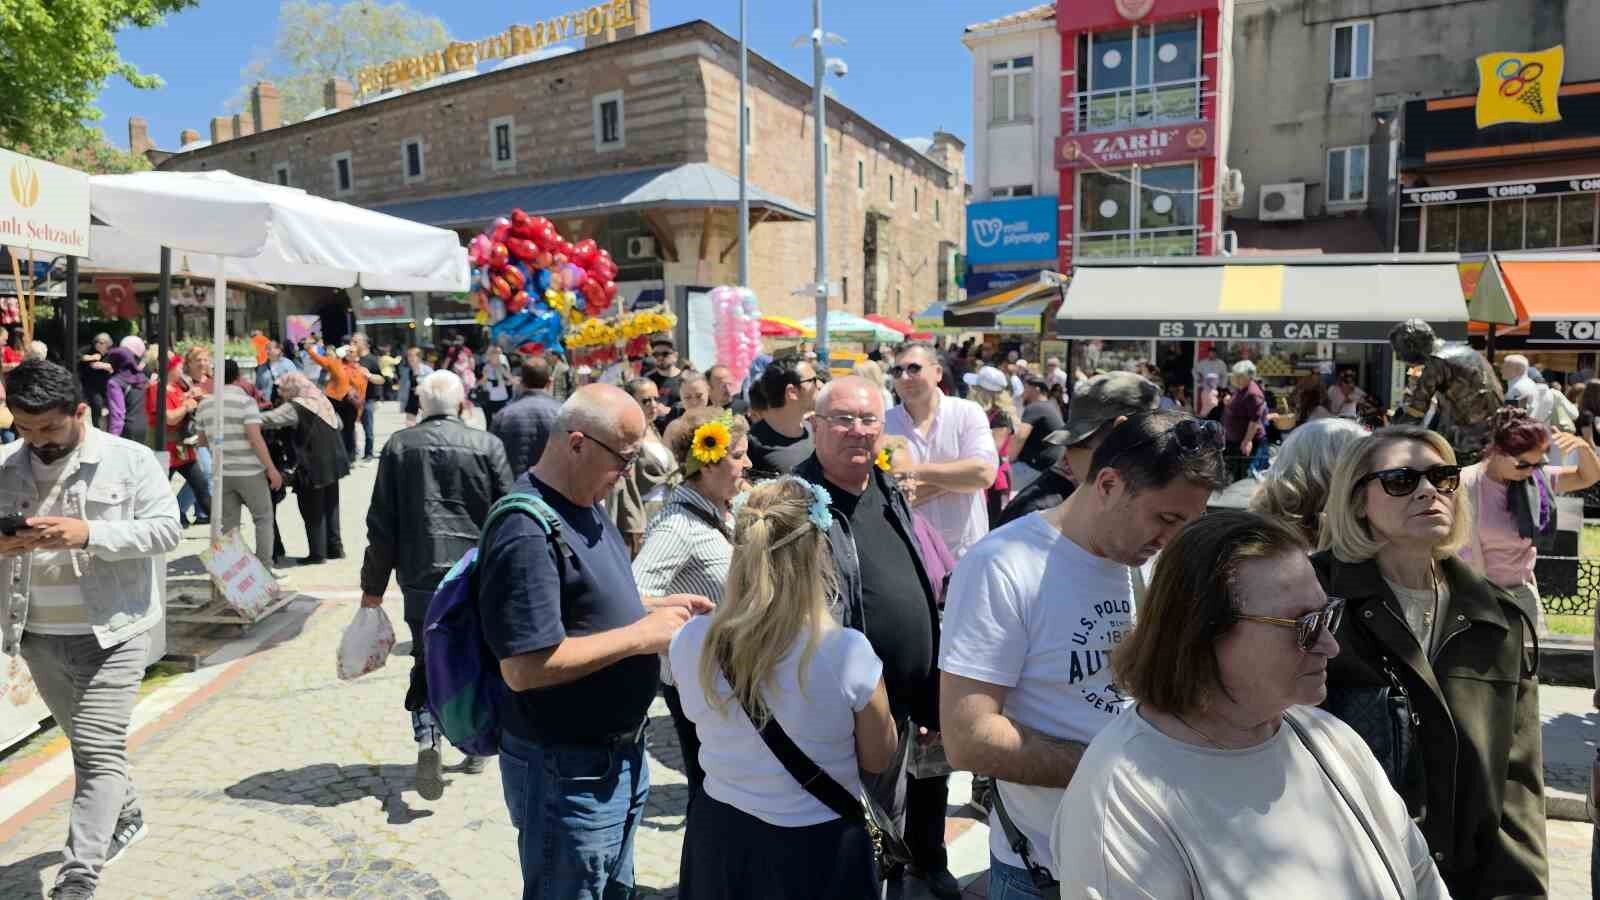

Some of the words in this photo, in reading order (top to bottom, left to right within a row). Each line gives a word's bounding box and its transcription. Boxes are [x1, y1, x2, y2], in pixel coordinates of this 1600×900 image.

[572, 0, 636, 37] HOTEL
[1499, 184, 1536, 196] ONDO
[1581, 180, 1600, 190] ON
[1421, 190, 1457, 202] ONDO
[1159, 323, 1184, 337] ES
[1194, 323, 1248, 337] TATLI
[1259, 323, 1273, 337] &
[1284, 323, 1340, 338] CAFE
[1072, 617, 1097, 645] U.S.
[1094, 600, 1130, 618] POLO
[1068, 650, 1114, 684] AUT
